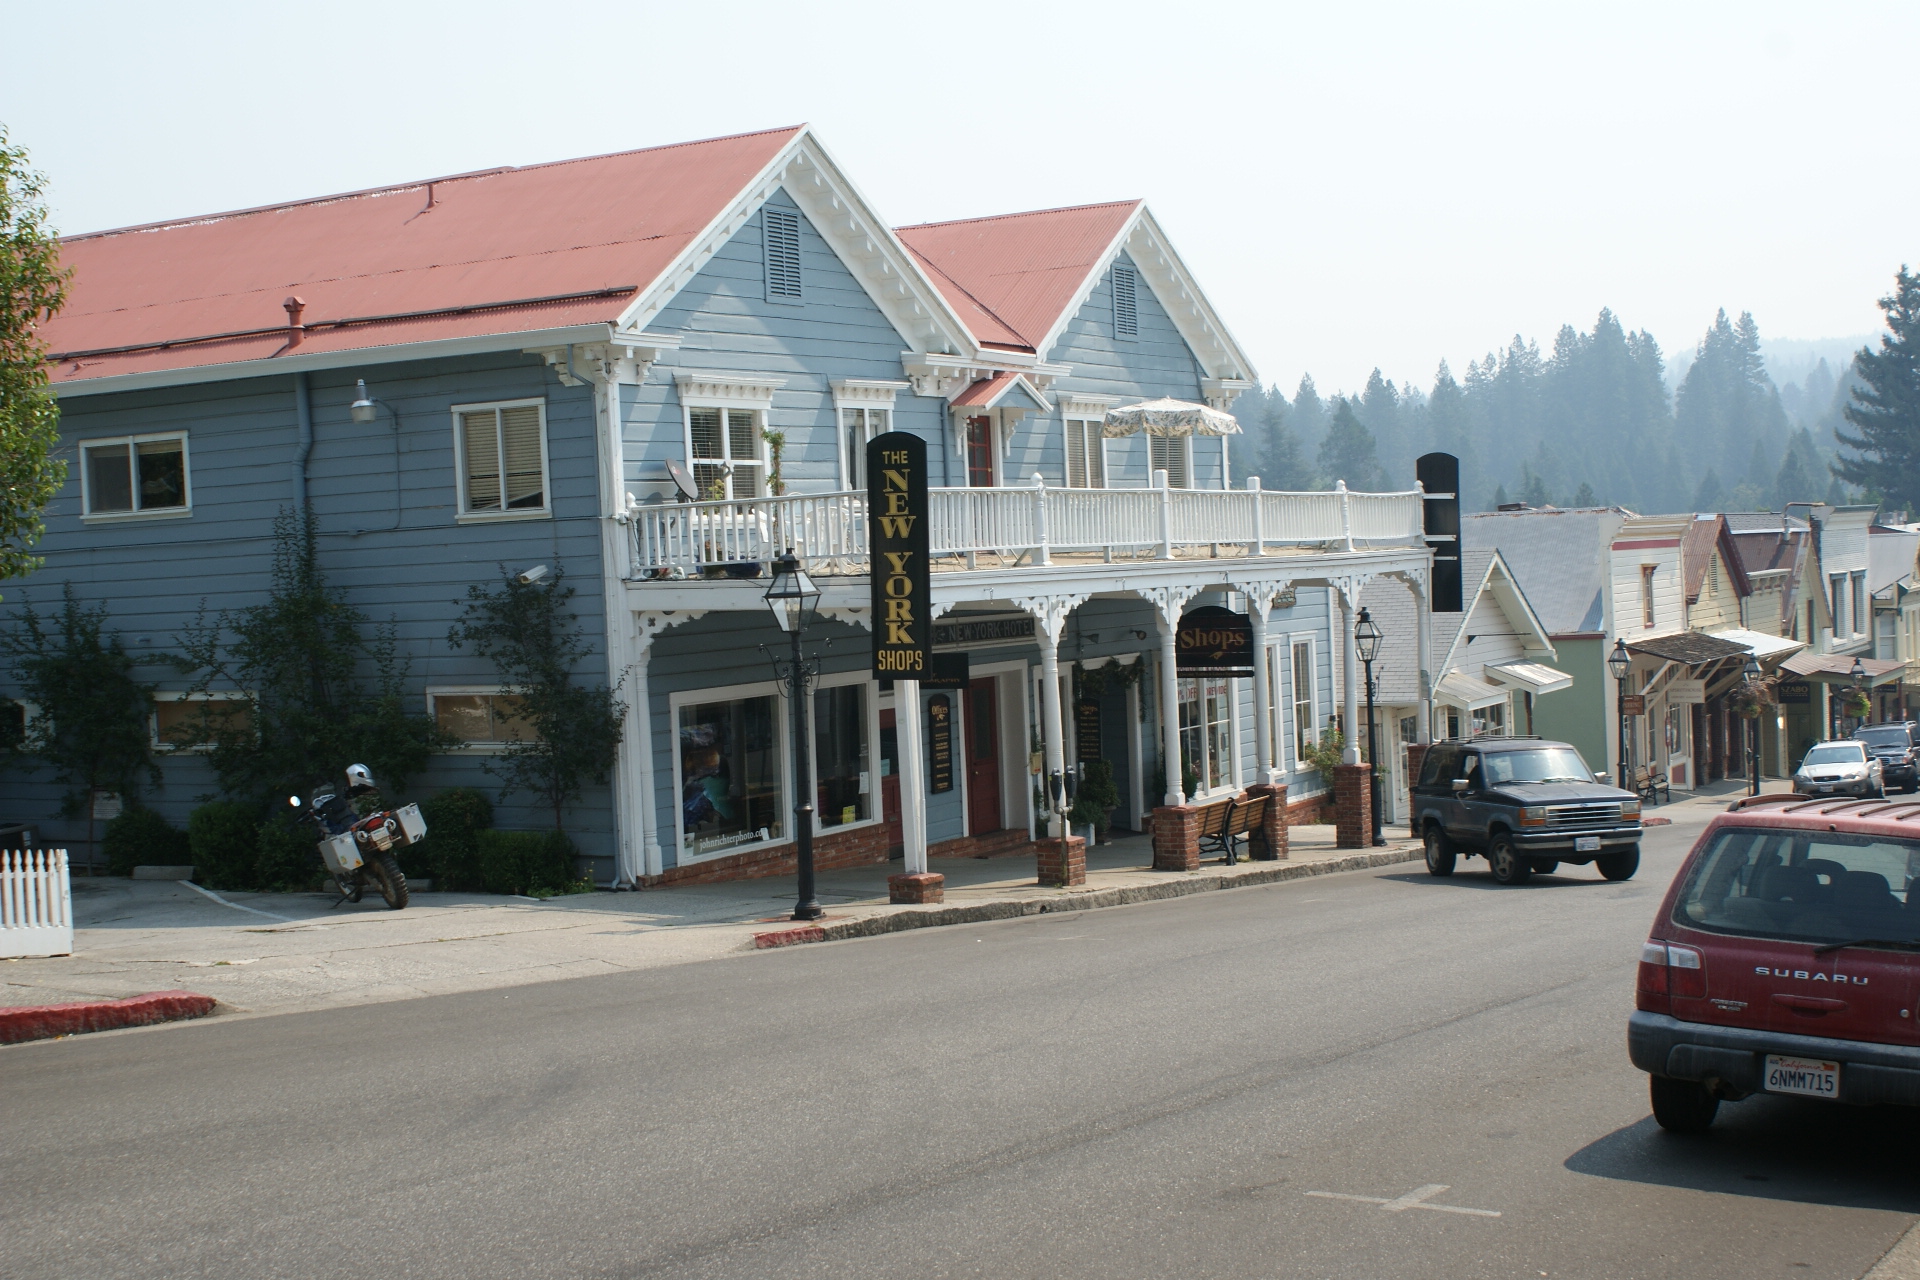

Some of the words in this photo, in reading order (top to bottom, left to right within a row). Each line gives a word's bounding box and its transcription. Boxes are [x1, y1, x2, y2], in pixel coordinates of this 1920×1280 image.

[882, 450, 909, 465] THE
[878, 468, 917, 539] NEW
[883, 551, 916, 645] YORK
[948, 624, 973, 641] NEW
[974, 621, 1002, 639] YORK
[1004, 618, 1035, 637] HOTEL
[1180, 627, 1245, 650] Shops
[878, 649, 923, 671] SHOPS
[1780, 685, 1809, 693] SZABO
[699, 829, 764, 852] johnrichterphoto.co
[1755, 966, 1869, 986] SUBARU
[1780, 1058, 1824, 1072] California
[1769, 1069, 1834, 1093] 6NMM715
